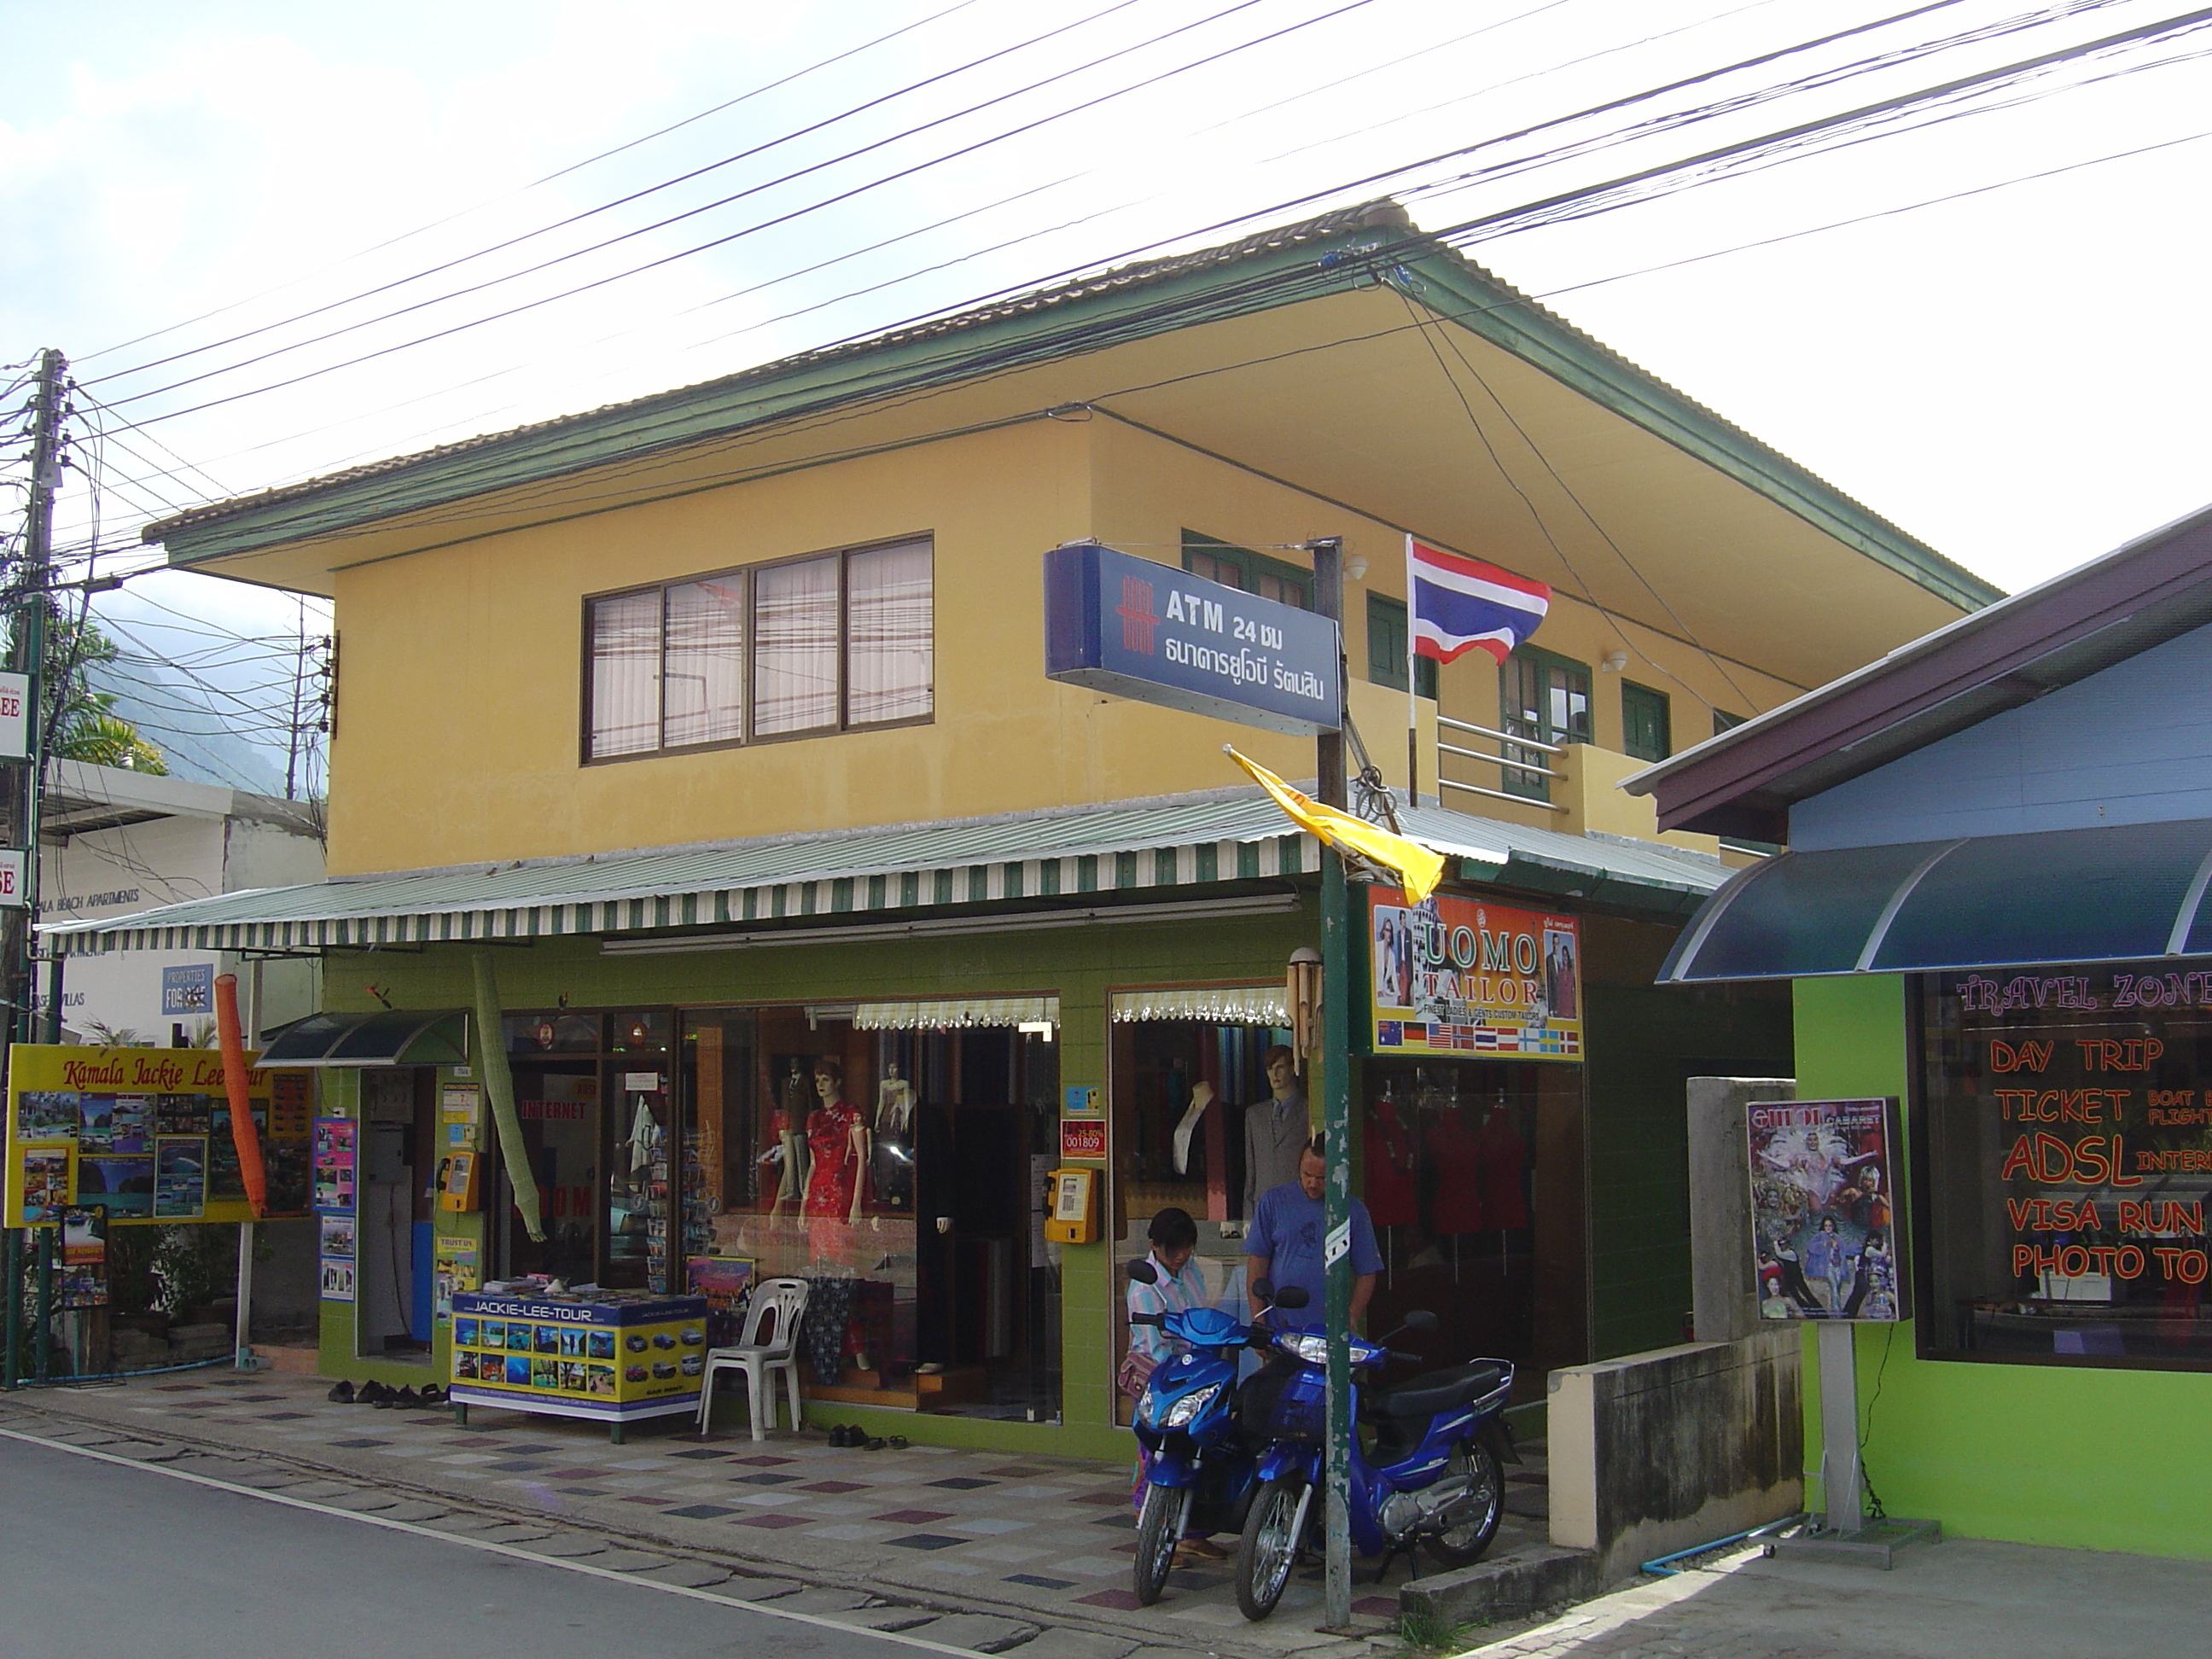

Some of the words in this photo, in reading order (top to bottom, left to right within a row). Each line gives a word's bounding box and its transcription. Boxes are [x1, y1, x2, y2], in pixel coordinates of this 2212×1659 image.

[1166, 590, 1224, 633] ATM
[1233, 616, 1256, 643] 24
[0, 697, 20, 717] EE
[57, 896, 83, 911] BEACH
[86, 889, 139, 907] APARTMENTS
[1422, 923, 1537, 975] UOMO
[167, 969, 206, 983] PROPERTIES
[1423, 972, 1539, 1004] TAILOR
[166, 987, 183, 1009] FOR
[186, 986, 206, 1007] SE
[1956, 974, 2098, 1016] TRAVEL
[1423, 1004, 1444, 1016] FINEST
[1446, 1005, 1466, 1016] LADIES
[1474, 1008, 1493, 1019] GENTS
[1494, 1010, 1516, 1020] CUSTOM
[1517, 1010, 1540, 1021] TAILORS
[1991, 1039, 2054, 1072] DAY
[2075, 1039, 2163, 1070] TRIP
[63, 1057, 124, 1091] Kamala
[131, 1057, 183, 1091] Jackie
[191, 1060, 224, 1086] Lee
[522, 1100, 586, 1120] INTERNET
[1994, 1088, 2131, 1123] TICKET
[2148, 1090, 2195, 1106] BOAT
[1067, 1137, 1099, 1148] 001809
[2002, 1132, 2144, 1187] ADSL
[2007, 1198, 2102, 1231] VISA
[2119, 1200, 2203, 1234] RUN
[2013, 1244, 2145, 1279] PHOTO
[2153, 1248, 2209, 1284] TO
[474, 1301, 592, 1322] JACKIE-LEE-TOUR
